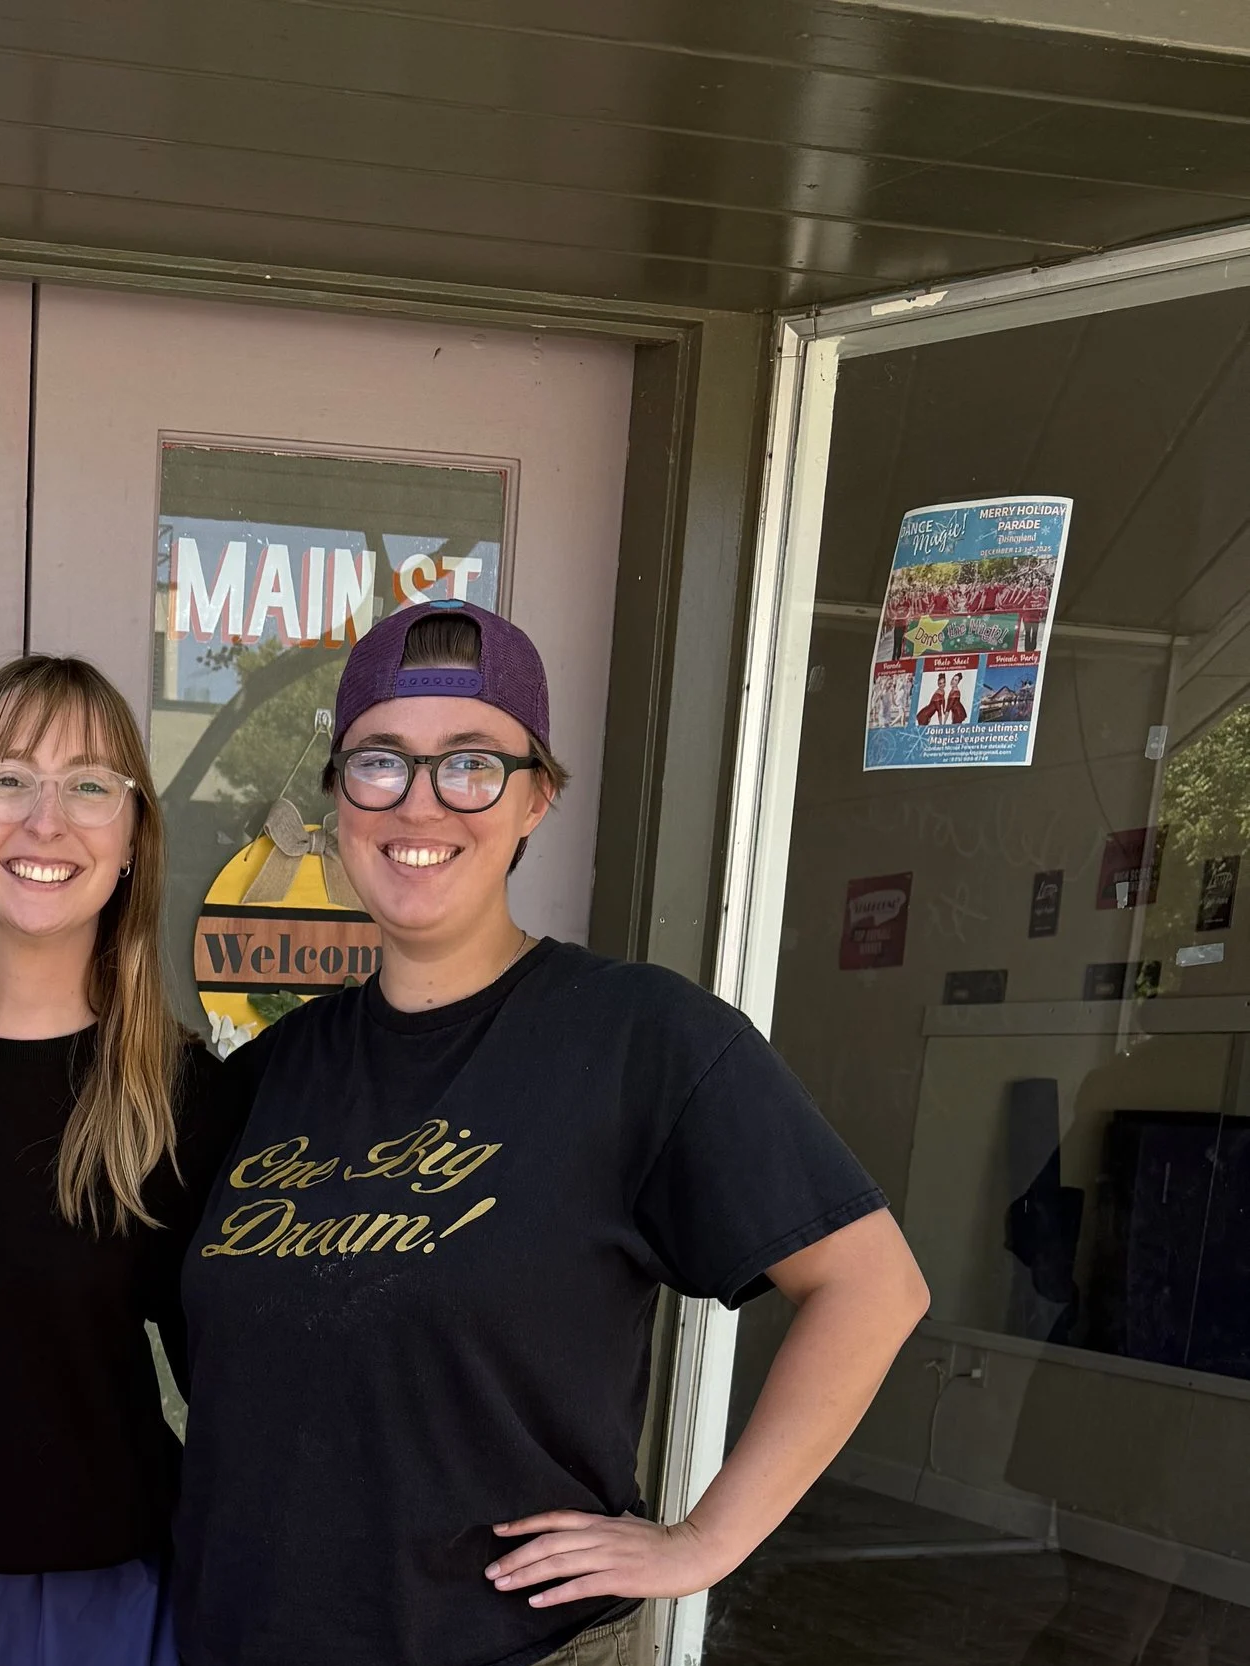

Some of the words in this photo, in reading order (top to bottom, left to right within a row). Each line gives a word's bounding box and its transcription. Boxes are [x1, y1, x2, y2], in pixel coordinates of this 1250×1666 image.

[979, 506, 1016, 520] MERRY
[1016, 504, 1068, 517] HOLIDAY
[997, 519, 1041, 532] PARADE
[168, 537, 377, 650] MAIN
[914, 627, 944, 648] Dance
[925, 726, 944, 736] Join
[945, 726, 956, 735] us
[971, 724, 986, 733] the
[988, 723, 1029, 733] ultimate
[930, 735, 963, 746] Magical
[202, 932, 383, 975] Welcom
[229, 1136, 340, 1190] One
[343, 1118, 503, 1194] Big
[201, 1197, 497, 1258] Dream!
